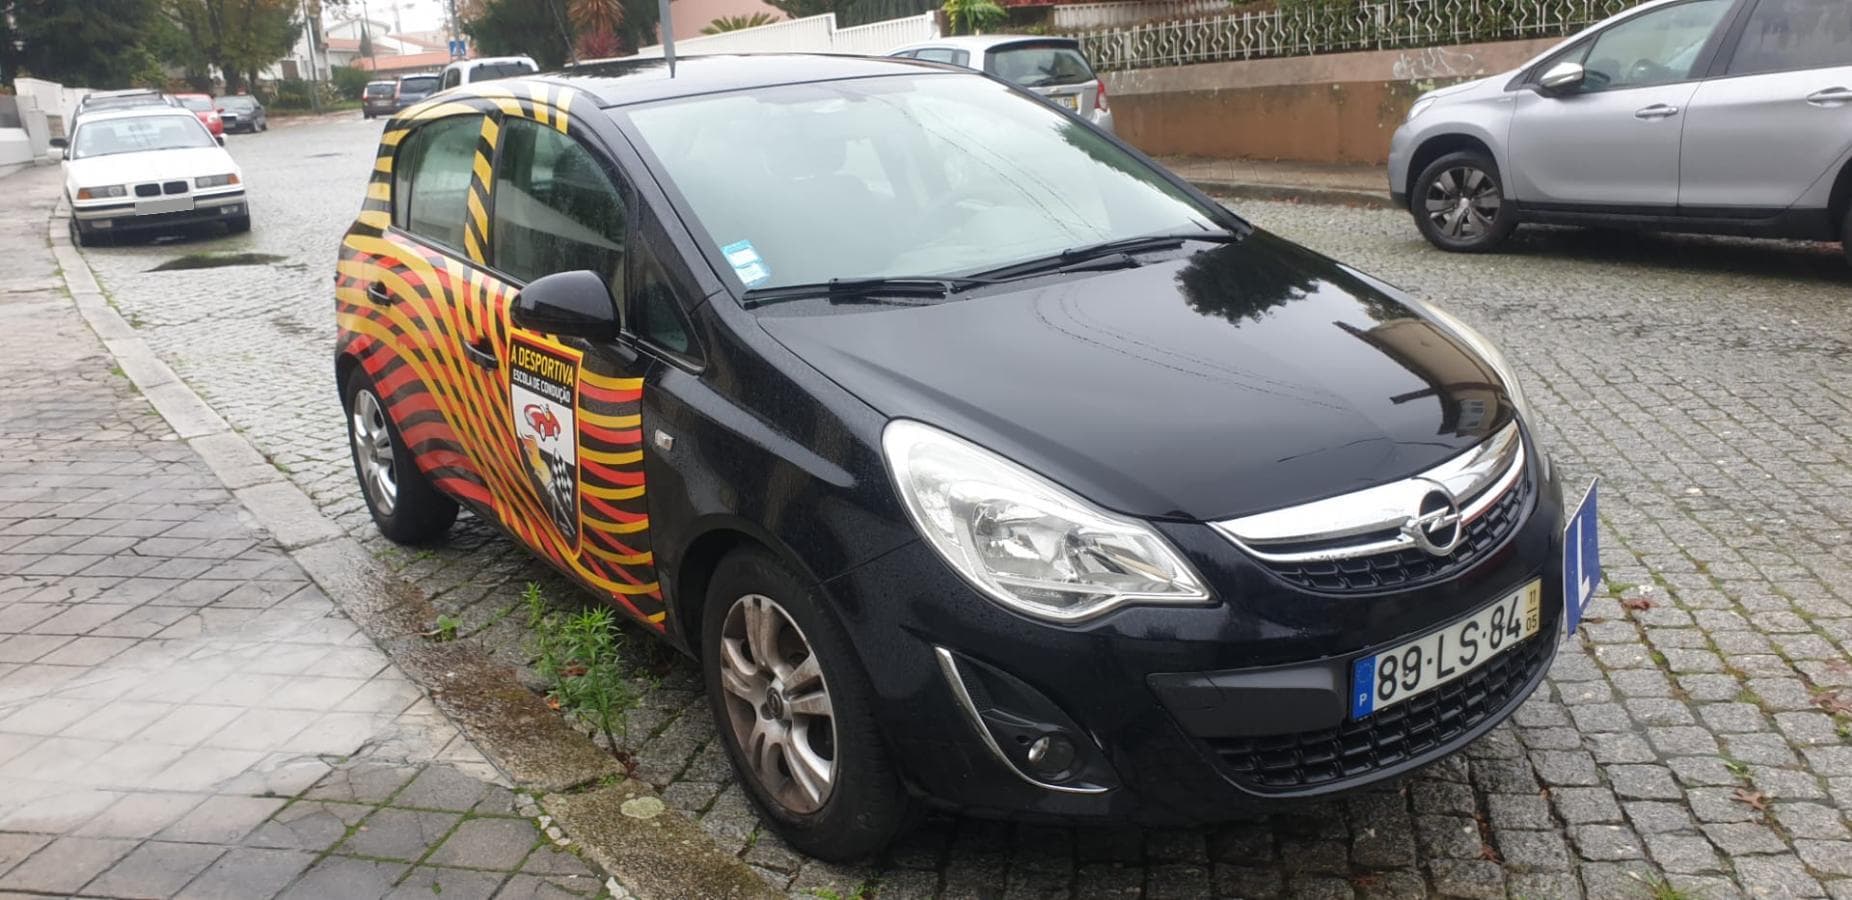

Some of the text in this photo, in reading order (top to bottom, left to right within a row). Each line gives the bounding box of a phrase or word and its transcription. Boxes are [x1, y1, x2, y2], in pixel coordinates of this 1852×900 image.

[511, 345, 573, 387] A DESPORTIVA
[513, 368, 571, 403] ESCOLA DE CONDUÇÃO
[1577, 515, 1590, 607] L
[1529, 589, 1537, 604] 11
[1526, 614, 1538, 631] 05
[1359, 694, 1367, 707] P
